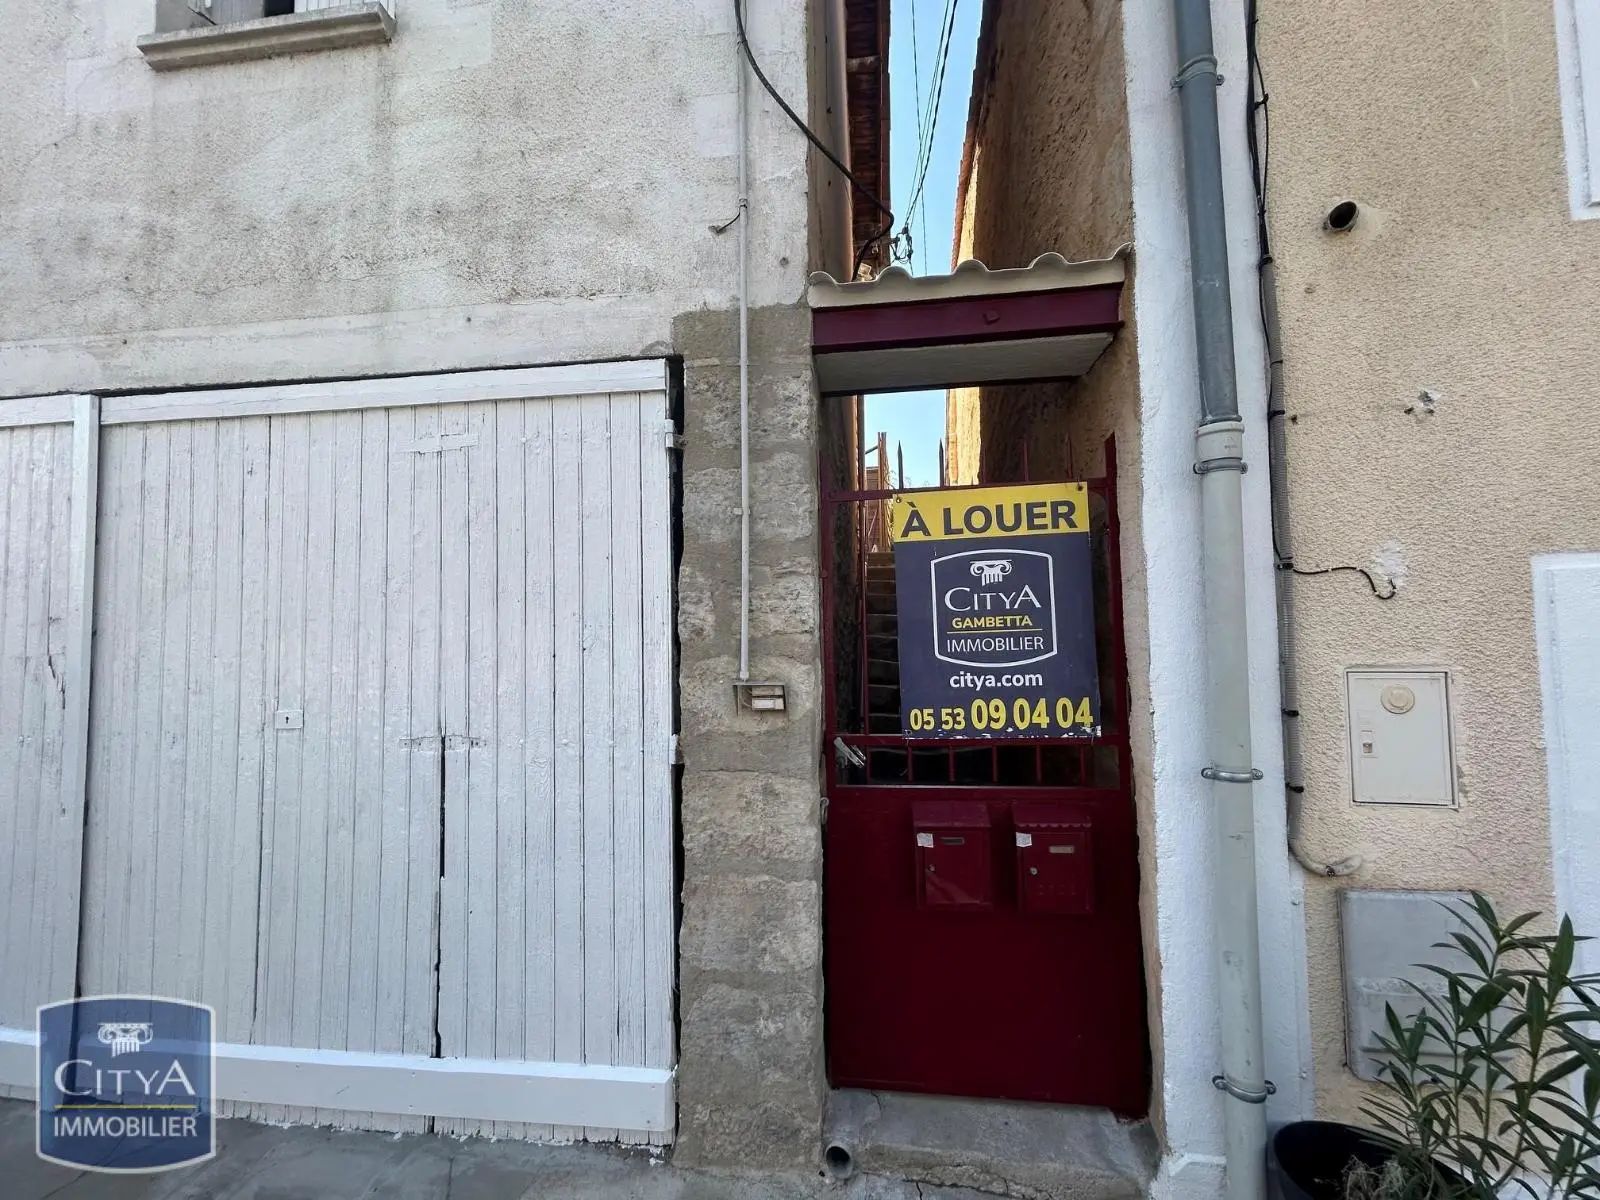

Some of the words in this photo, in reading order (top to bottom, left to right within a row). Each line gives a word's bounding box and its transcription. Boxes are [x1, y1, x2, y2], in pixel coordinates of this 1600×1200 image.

[900, 501, 931, 538] À
[943, 500, 1079, 536] LOUER
[944, 584, 1042, 612] CITYA
[952, 615, 1033, 629] GAMBETTA
[947, 636, 1044, 653] IMMOBILIER
[949, 671, 1043, 691] citya.com
[909, 708, 935, 730] 05
[941, 707, 966, 730] 53
[971, 698, 1007, 730] 09
[1013, 697, 1050, 729] 04
[1055, 696, 1093, 729] 04
